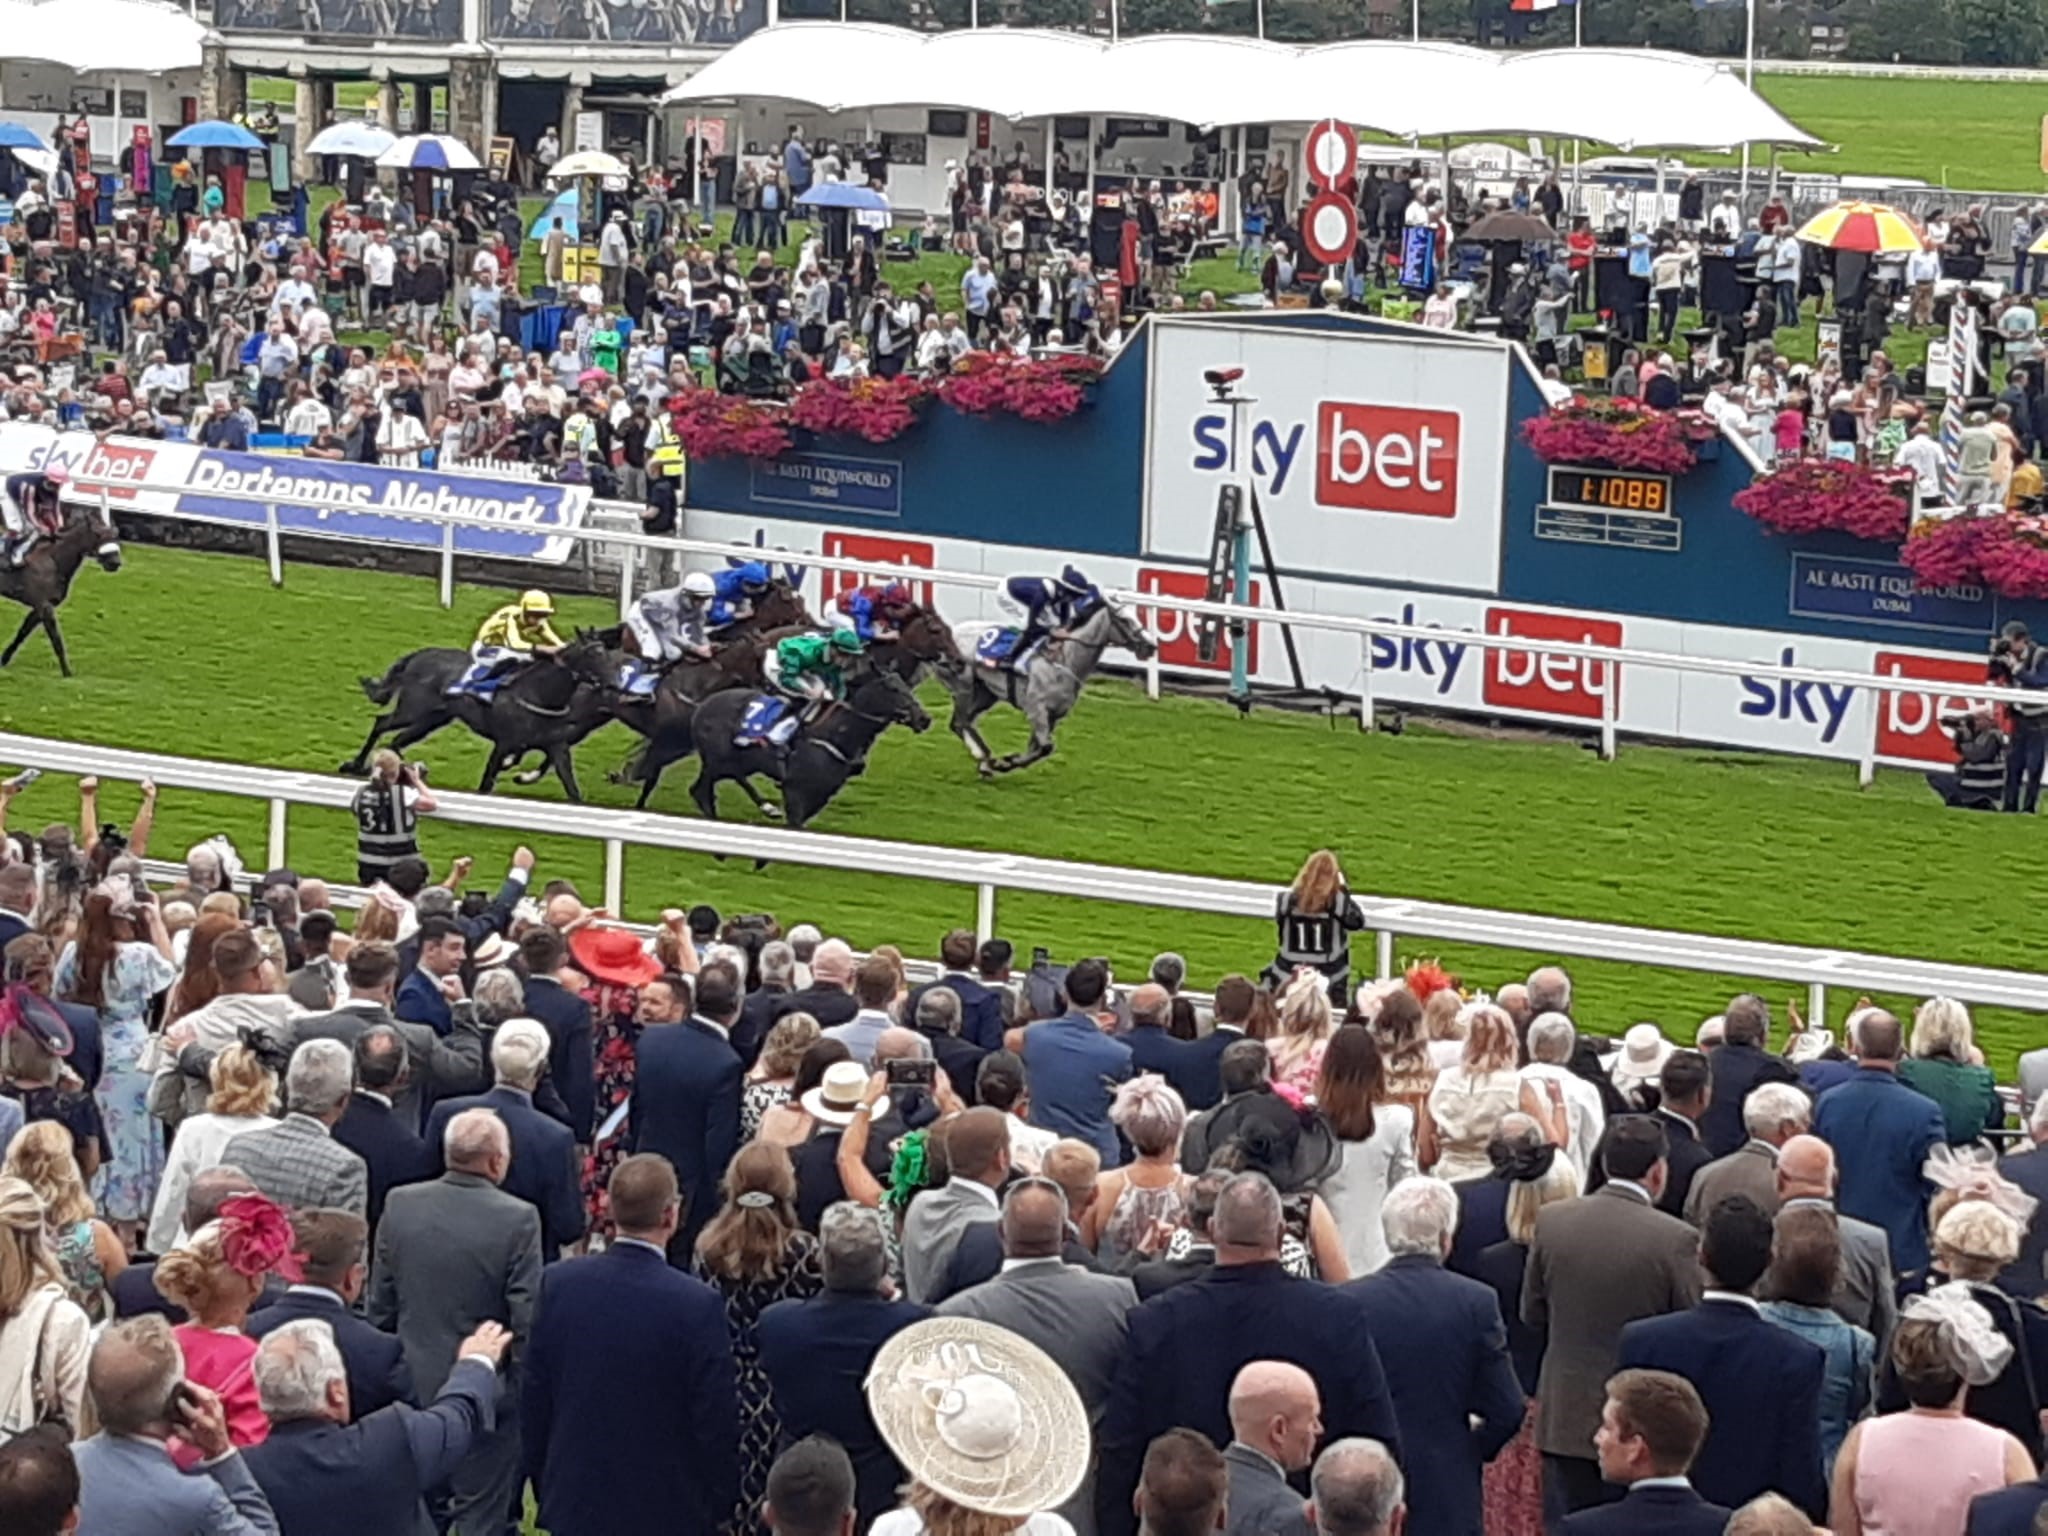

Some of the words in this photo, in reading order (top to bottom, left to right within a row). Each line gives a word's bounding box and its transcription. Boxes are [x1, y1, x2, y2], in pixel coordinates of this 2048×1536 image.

[87, 444, 147, 481] bet
[1331, 411, 1444, 493] bet
[193, 459, 371, 519] Pertemps
[381, 480, 545, 534] Network
[1806, 569, 1826, 586] AL
[1831, 571, 1875, 592] BASTI
[1880, 576, 1983, 602] EQUWORLD
[1872, 598, 1912, 613] DUBAI
[979, 628, 999, 649] 9
[1370, 603, 1474, 694] sky
[1498, 617, 1606, 695] bet
[745, 702, 765, 720] 7
[1740, 647, 1855, 743] sky
[1296, 923, 1325, 951] 11
